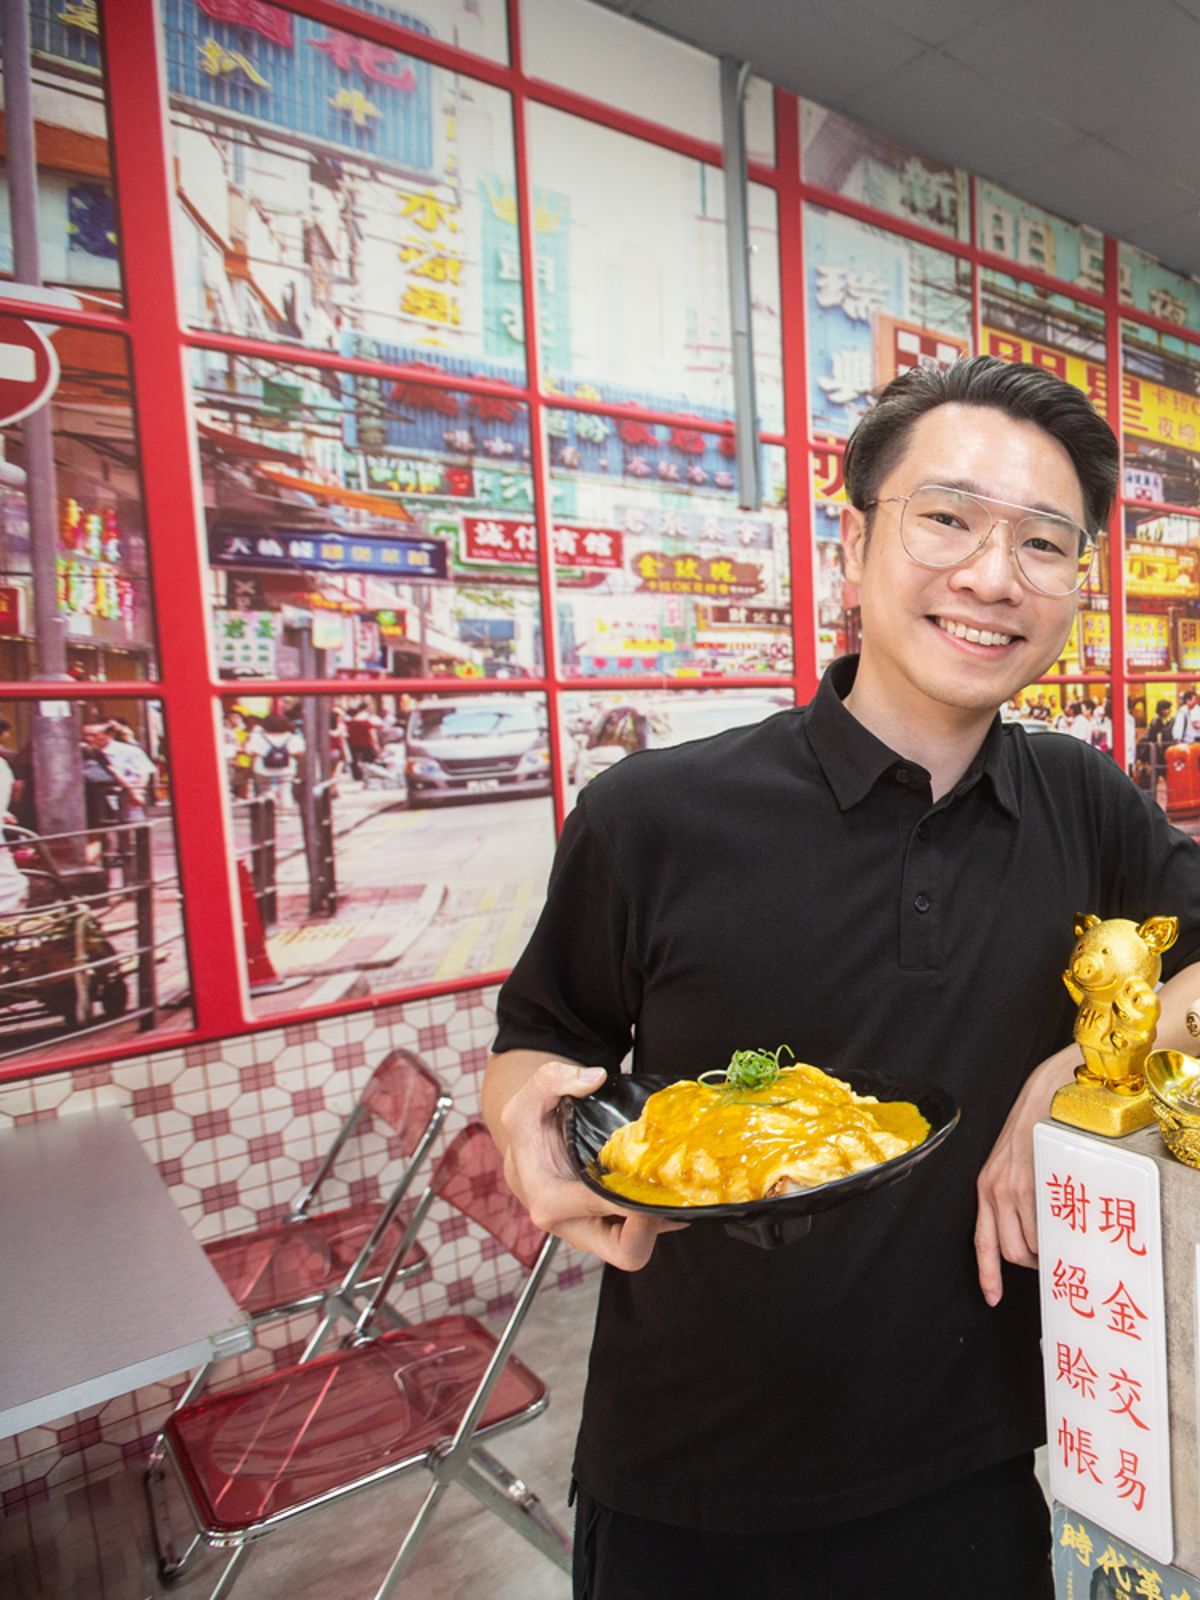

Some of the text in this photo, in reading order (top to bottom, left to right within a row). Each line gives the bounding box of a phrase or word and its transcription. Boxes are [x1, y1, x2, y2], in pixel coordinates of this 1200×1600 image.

[1045, 1172, 1104, 1486] 謝絕賒帳
[1098, 1196, 1151, 1512] 現金交易
[1060, 1523, 1192, 1600] 時代革
